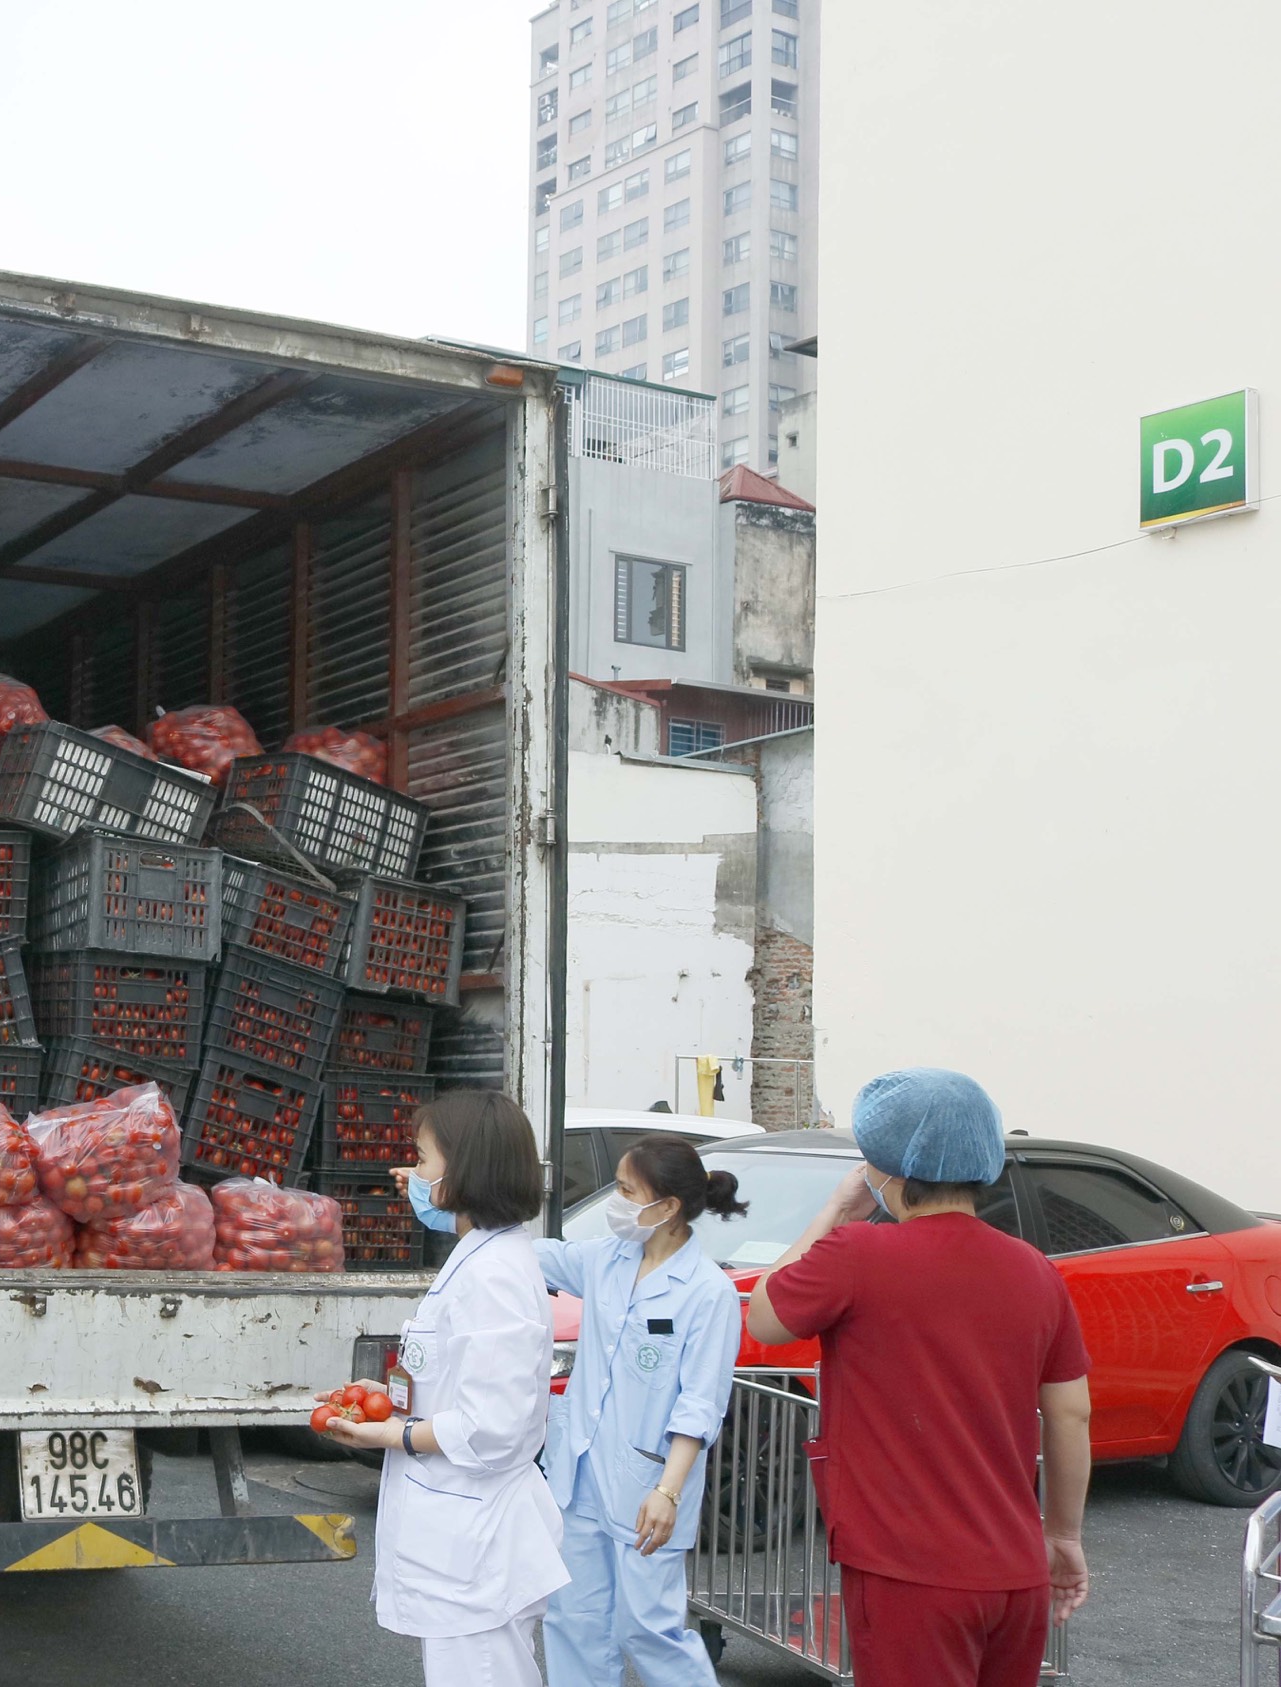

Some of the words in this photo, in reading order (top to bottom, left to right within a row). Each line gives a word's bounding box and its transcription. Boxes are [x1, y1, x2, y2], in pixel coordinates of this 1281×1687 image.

[1152, 428, 1234, 494] D2
[48, 1431, 109, 1470] 98C
[30, 1471, 136, 1514] 145.46
